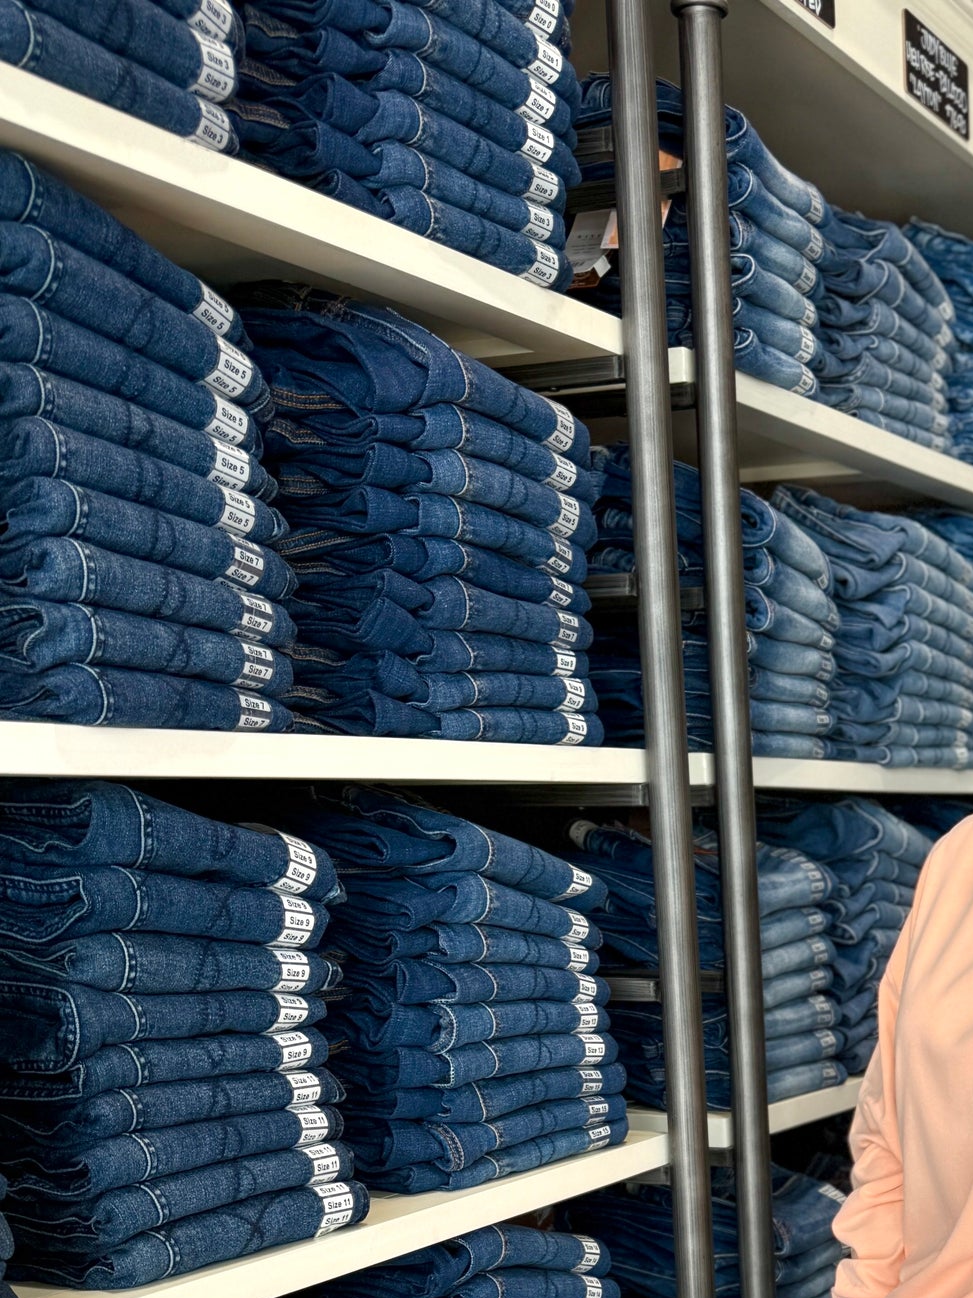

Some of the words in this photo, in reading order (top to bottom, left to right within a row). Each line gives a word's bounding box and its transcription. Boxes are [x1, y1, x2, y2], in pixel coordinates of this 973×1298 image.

[207, 1, 223, 18] Size
[222, 15, 226, 24] 3
[534, 13, 547, 26] Size
[547, 21, 552, 29] 0
[543, 50, 554, 62] Size
[534, 66, 547, 77] Size
[205, 74, 221, 87] Size
[222, 82, 227, 90] 3
[531, 99, 544, 111] Size
[203, 125, 218, 140] Size
[218, 134, 223, 144] 3
[527, 146, 541, 155] Size
[541, 151, 546, 159] 1
[534, 184, 548, 193] Size
[548, 189, 553, 197] 3
[534, 268, 546, 277] Size
[546, 272, 552, 280] 3
[201, 309, 217, 324] Size
[217, 322, 224, 330] 5
[224, 360, 240, 375] Size
[241, 370, 247, 380] 5
[213, 376, 229, 389] Size
[222, 408, 236, 423] Size
[238, 417, 243, 427] 5
[222, 458, 238, 472] Size
[239, 466, 244, 475] 5
[556, 471, 567, 480] Size
[228, 512, 243, 524] Size
[244, 519, 249, 527] 5
[240, 551, 254, 563] Size
[255, 557, 260, 566] 7
[232, 569, 247, 580] Size
[247, 617, 261, 628] Size
[262, 622, 268, 630] 7
[249, 665, 263, 674] Size
[263, 669, 269, 677] 7
[244, 718, 259, 726] Size
[292, 868, 305, 879] Size
[305, 873, 310, 881] 9
[290, 917, 304, 926] Size
[305, 919, 310, 927] 9
[287, 969, 300, 977] Size
[288, 1050, 301, 1059] Size
[302, 1048, 307, 1056] 9
[296, 1092, 309, 1100] Size
[311, 1090, 318, 1098] 11
[317, 1162, 329, 1171] Size
[328, 1201, 342, 1209] Size
[343, 1198, 350, 1206] 11
[325, 1217, 340, 1225] Size
